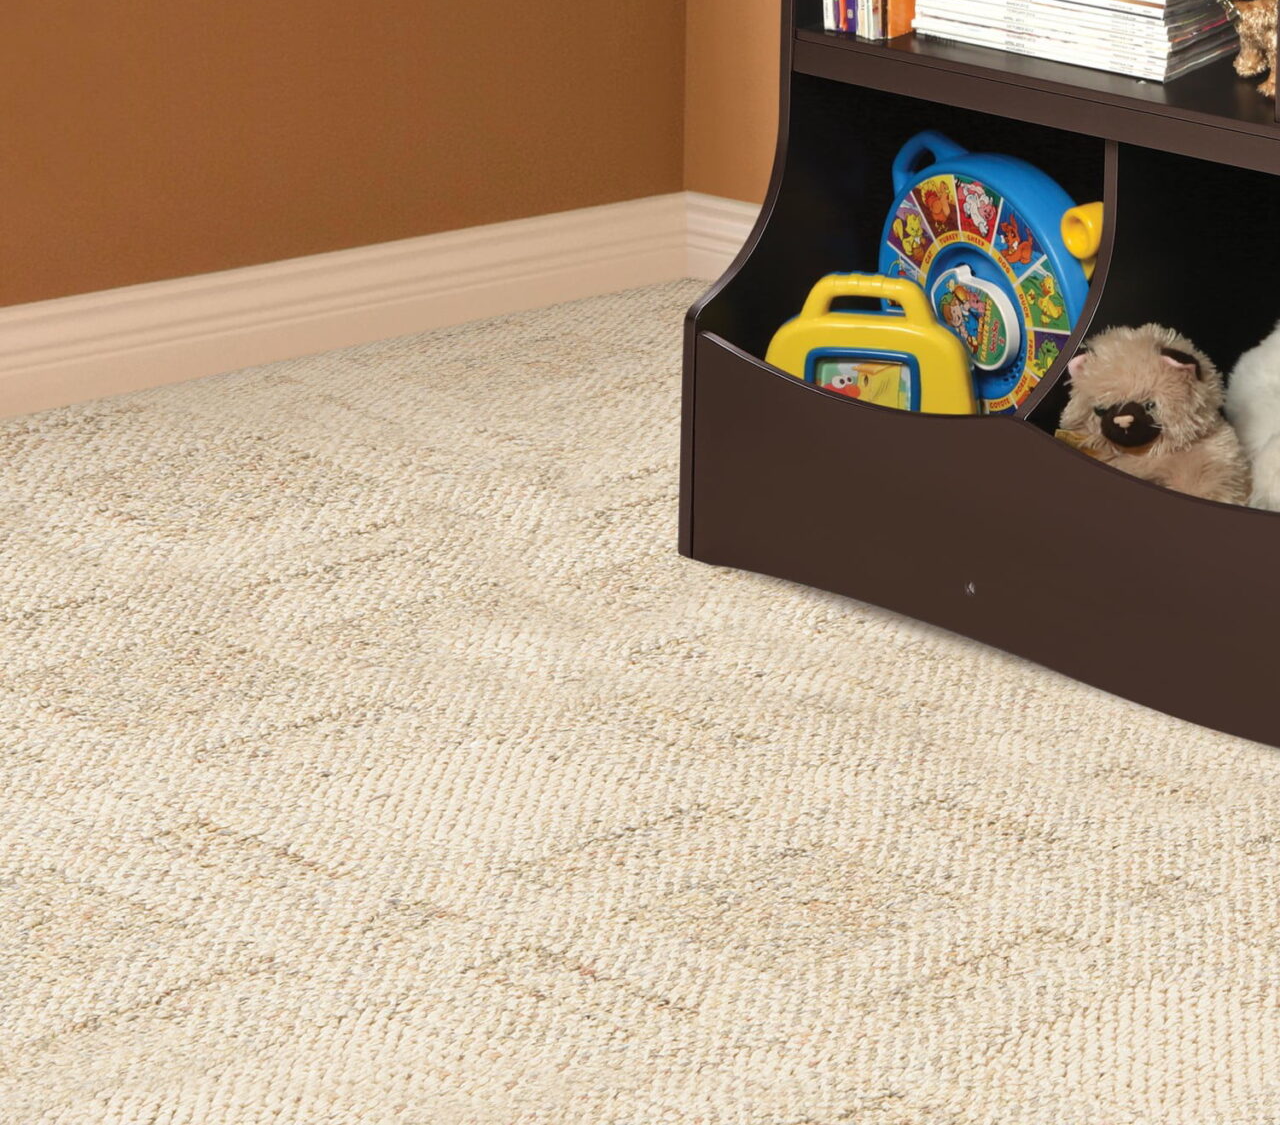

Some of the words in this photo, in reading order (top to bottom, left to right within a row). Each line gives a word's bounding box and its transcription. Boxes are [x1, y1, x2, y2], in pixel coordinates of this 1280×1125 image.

[939, 233, 959, 244] TURKEY
[967, 235, 985, 247] SHEEP
[924, 251, 933, 264] CAT
[998, 256, 1010, 274] DOG
[1019, 293, 1029, 319] DUCK
[989, 399, 1010, 409] COYOTE
